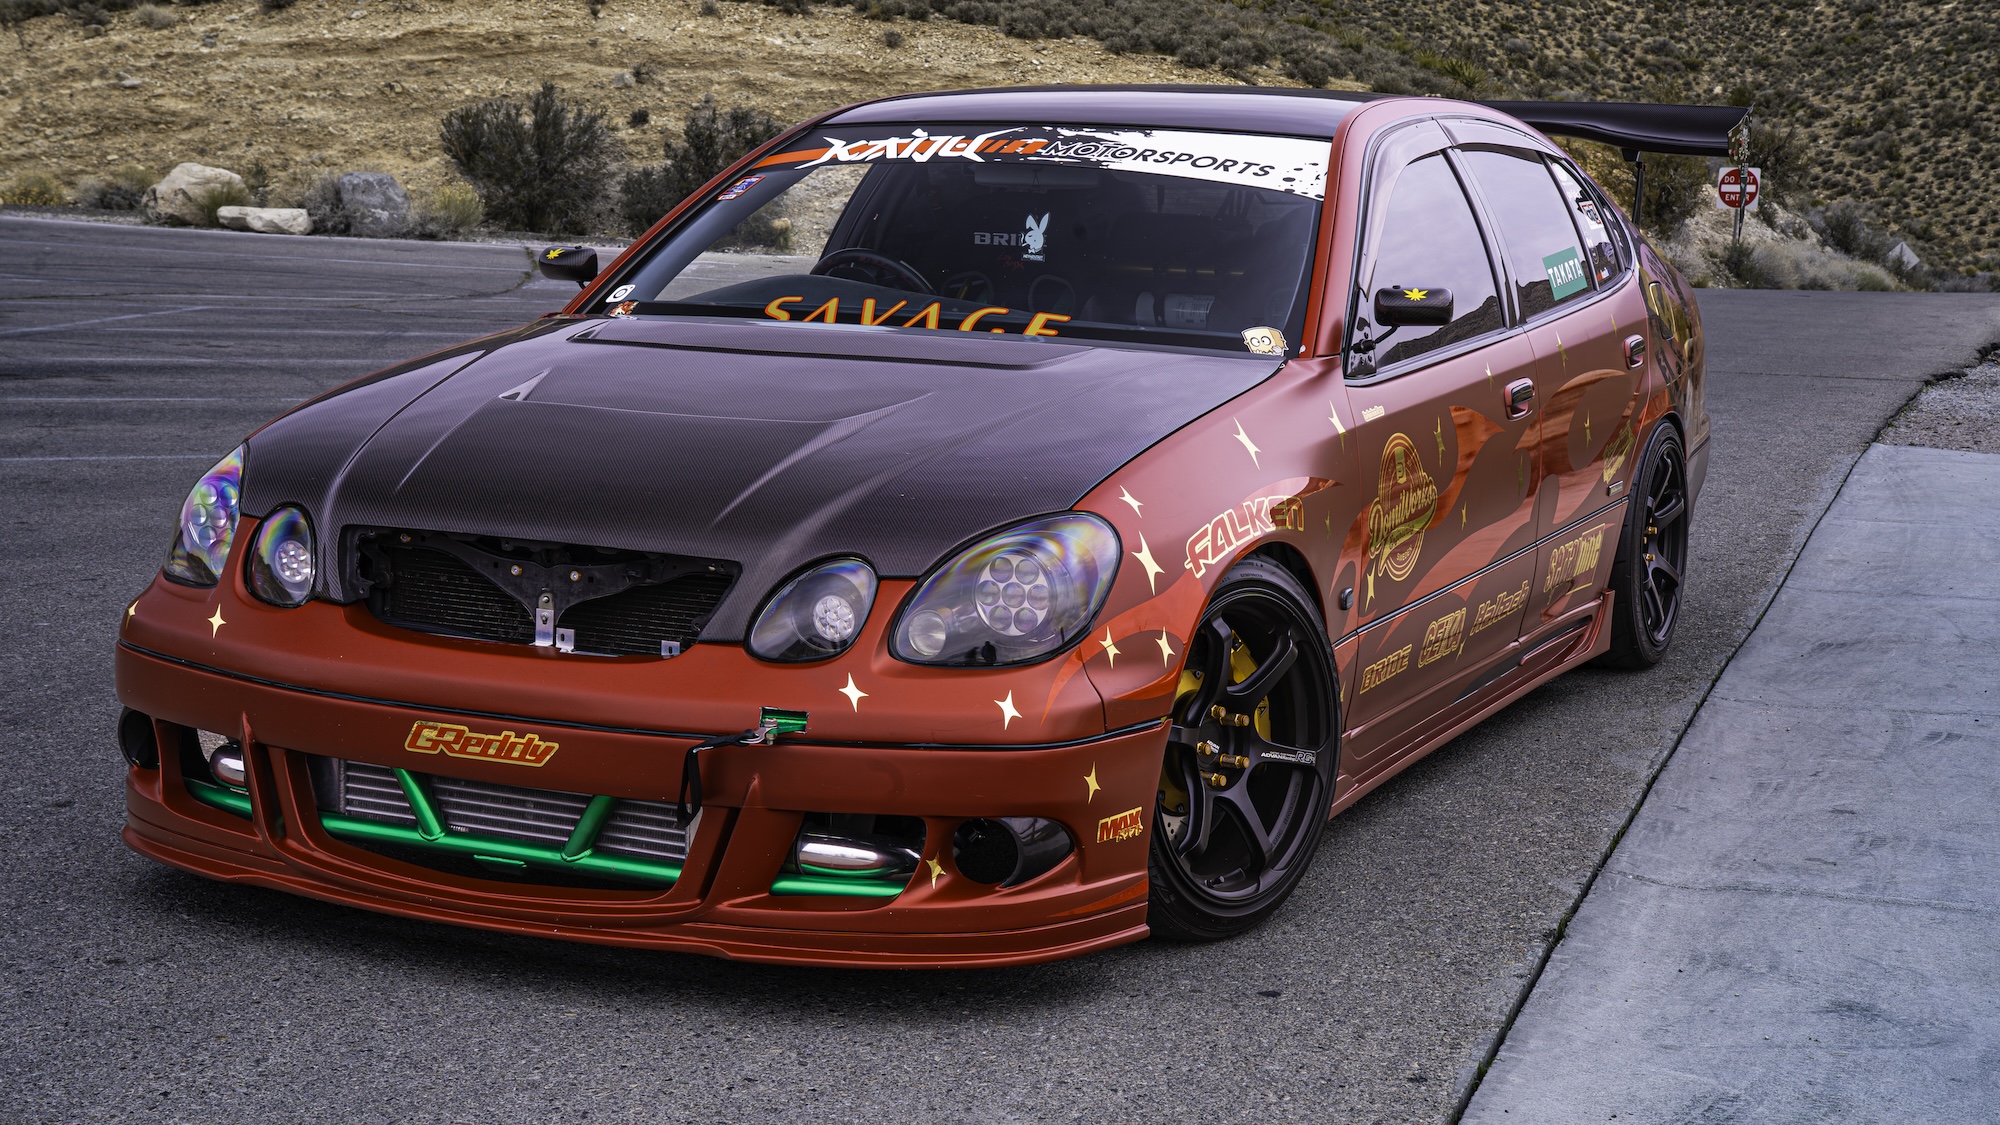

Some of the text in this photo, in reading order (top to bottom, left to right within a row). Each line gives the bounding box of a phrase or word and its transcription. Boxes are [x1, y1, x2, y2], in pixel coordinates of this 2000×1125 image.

[1042, 140, 1275, 177] MOTORSPORTS
[1724, 175, 1735, 183] DO
[1725, 193, 1750, 201] ENTR
[1547, 258, 1583, 288] TAKATA
[1184, 495, 1304, 578] FALKEN
[1359, 643, 1412, 695] BRIDE
